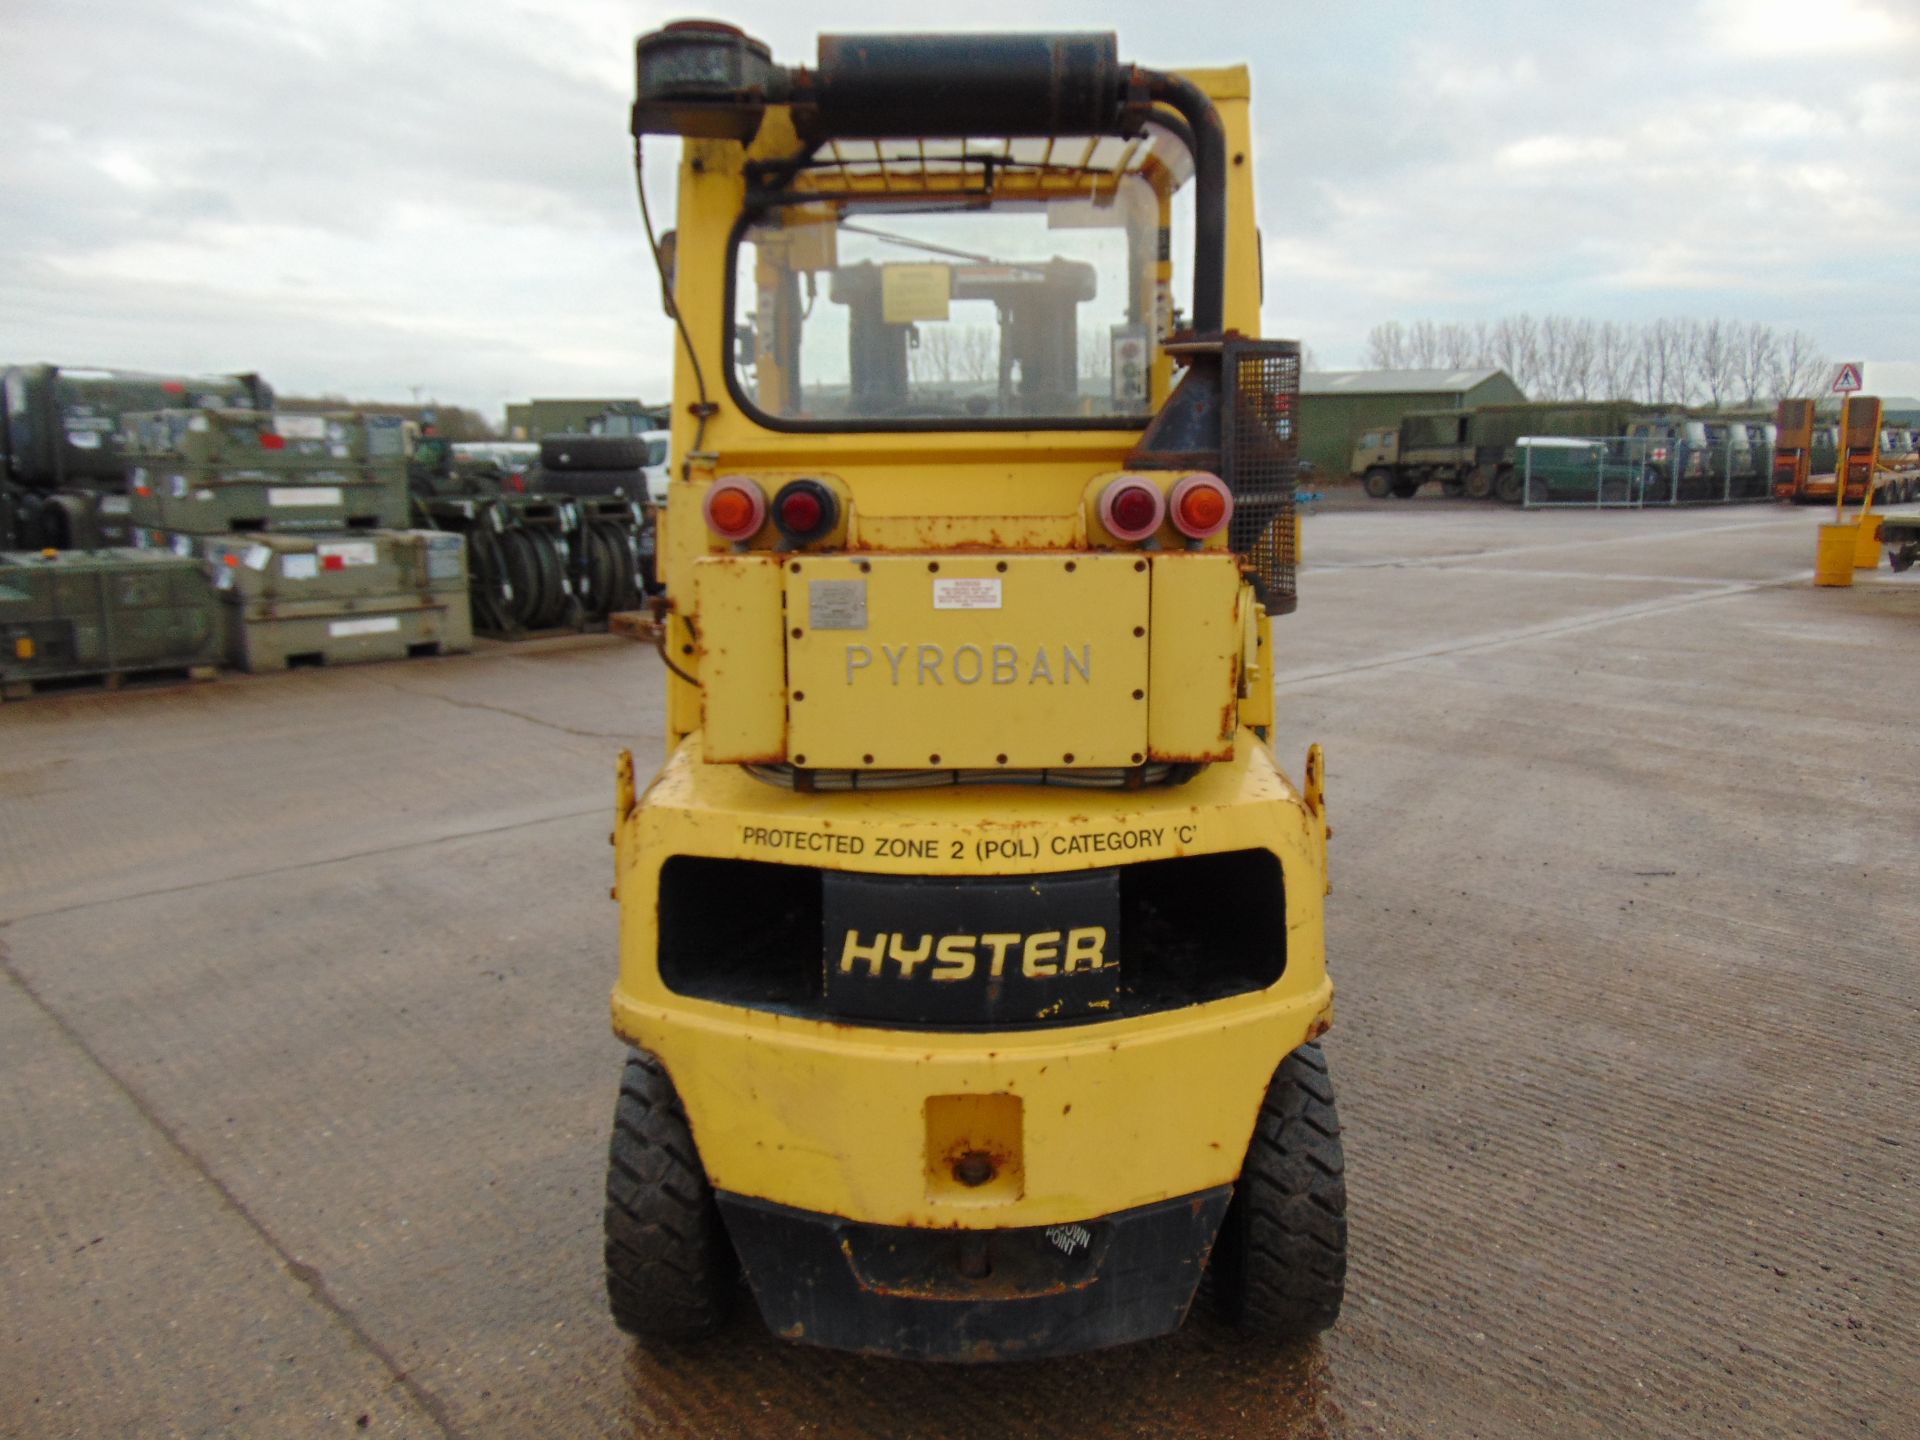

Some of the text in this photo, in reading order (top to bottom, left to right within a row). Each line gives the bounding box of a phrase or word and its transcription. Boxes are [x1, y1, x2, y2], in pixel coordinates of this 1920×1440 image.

[845, 643, 1092, 686] PYROBAN
[742, 826, 865, 855] PROTECTED
[874, 837, 939, 859] ZONE
[951, 840, 965, 860] 2
[975, 836, 1040, 862] (POL)
[1050, 827, 1165, 855] CATEGORY
[839, 926, 1107, 981] HYSTER
